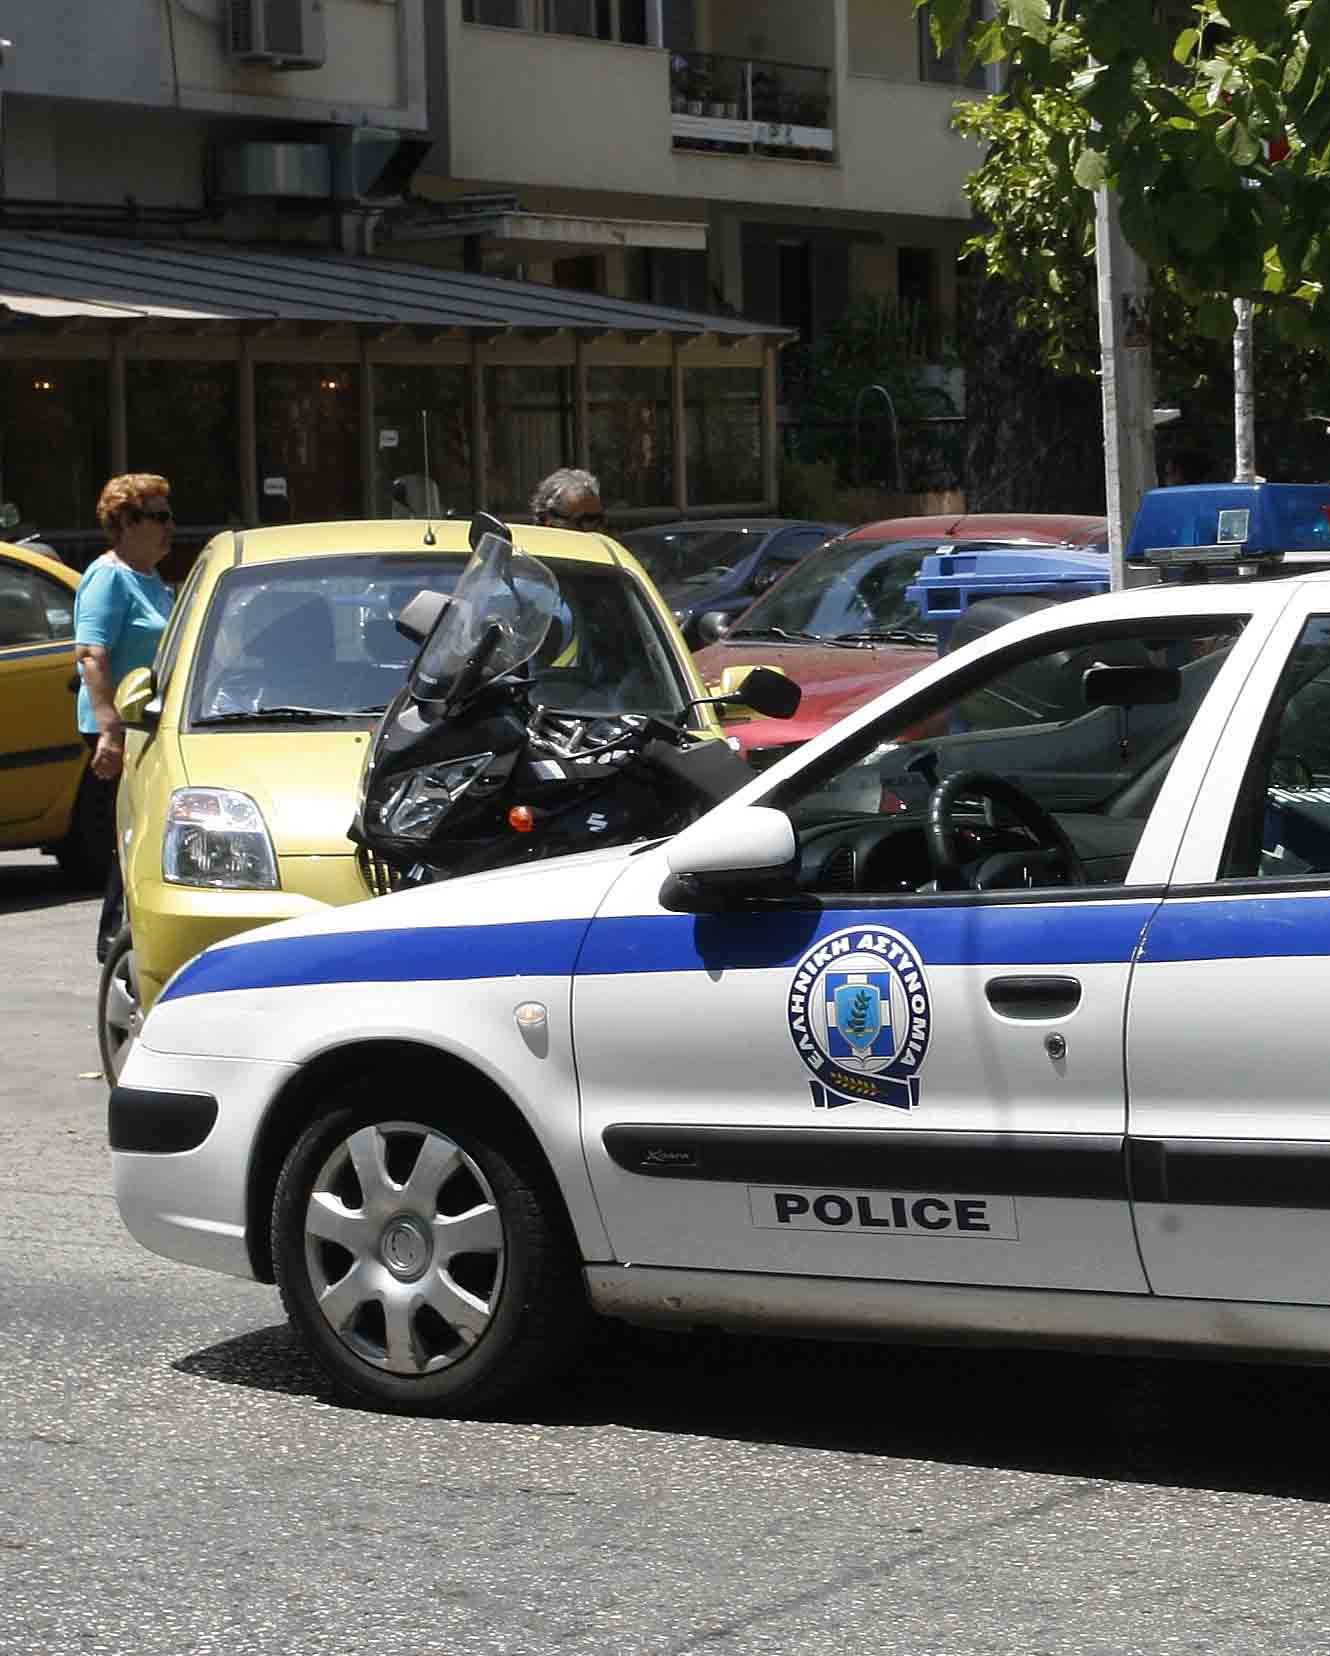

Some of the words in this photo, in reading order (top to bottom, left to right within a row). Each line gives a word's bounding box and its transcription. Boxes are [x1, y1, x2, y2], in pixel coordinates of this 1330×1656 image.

[791, 938, 850, 1071] ΕΛΛΗΝΙΚΗ
[857, 934, 927, 1067] ΑΣΤΥΝΟΜΙΑ
[774, 1192, 991, 1231] POLICE
